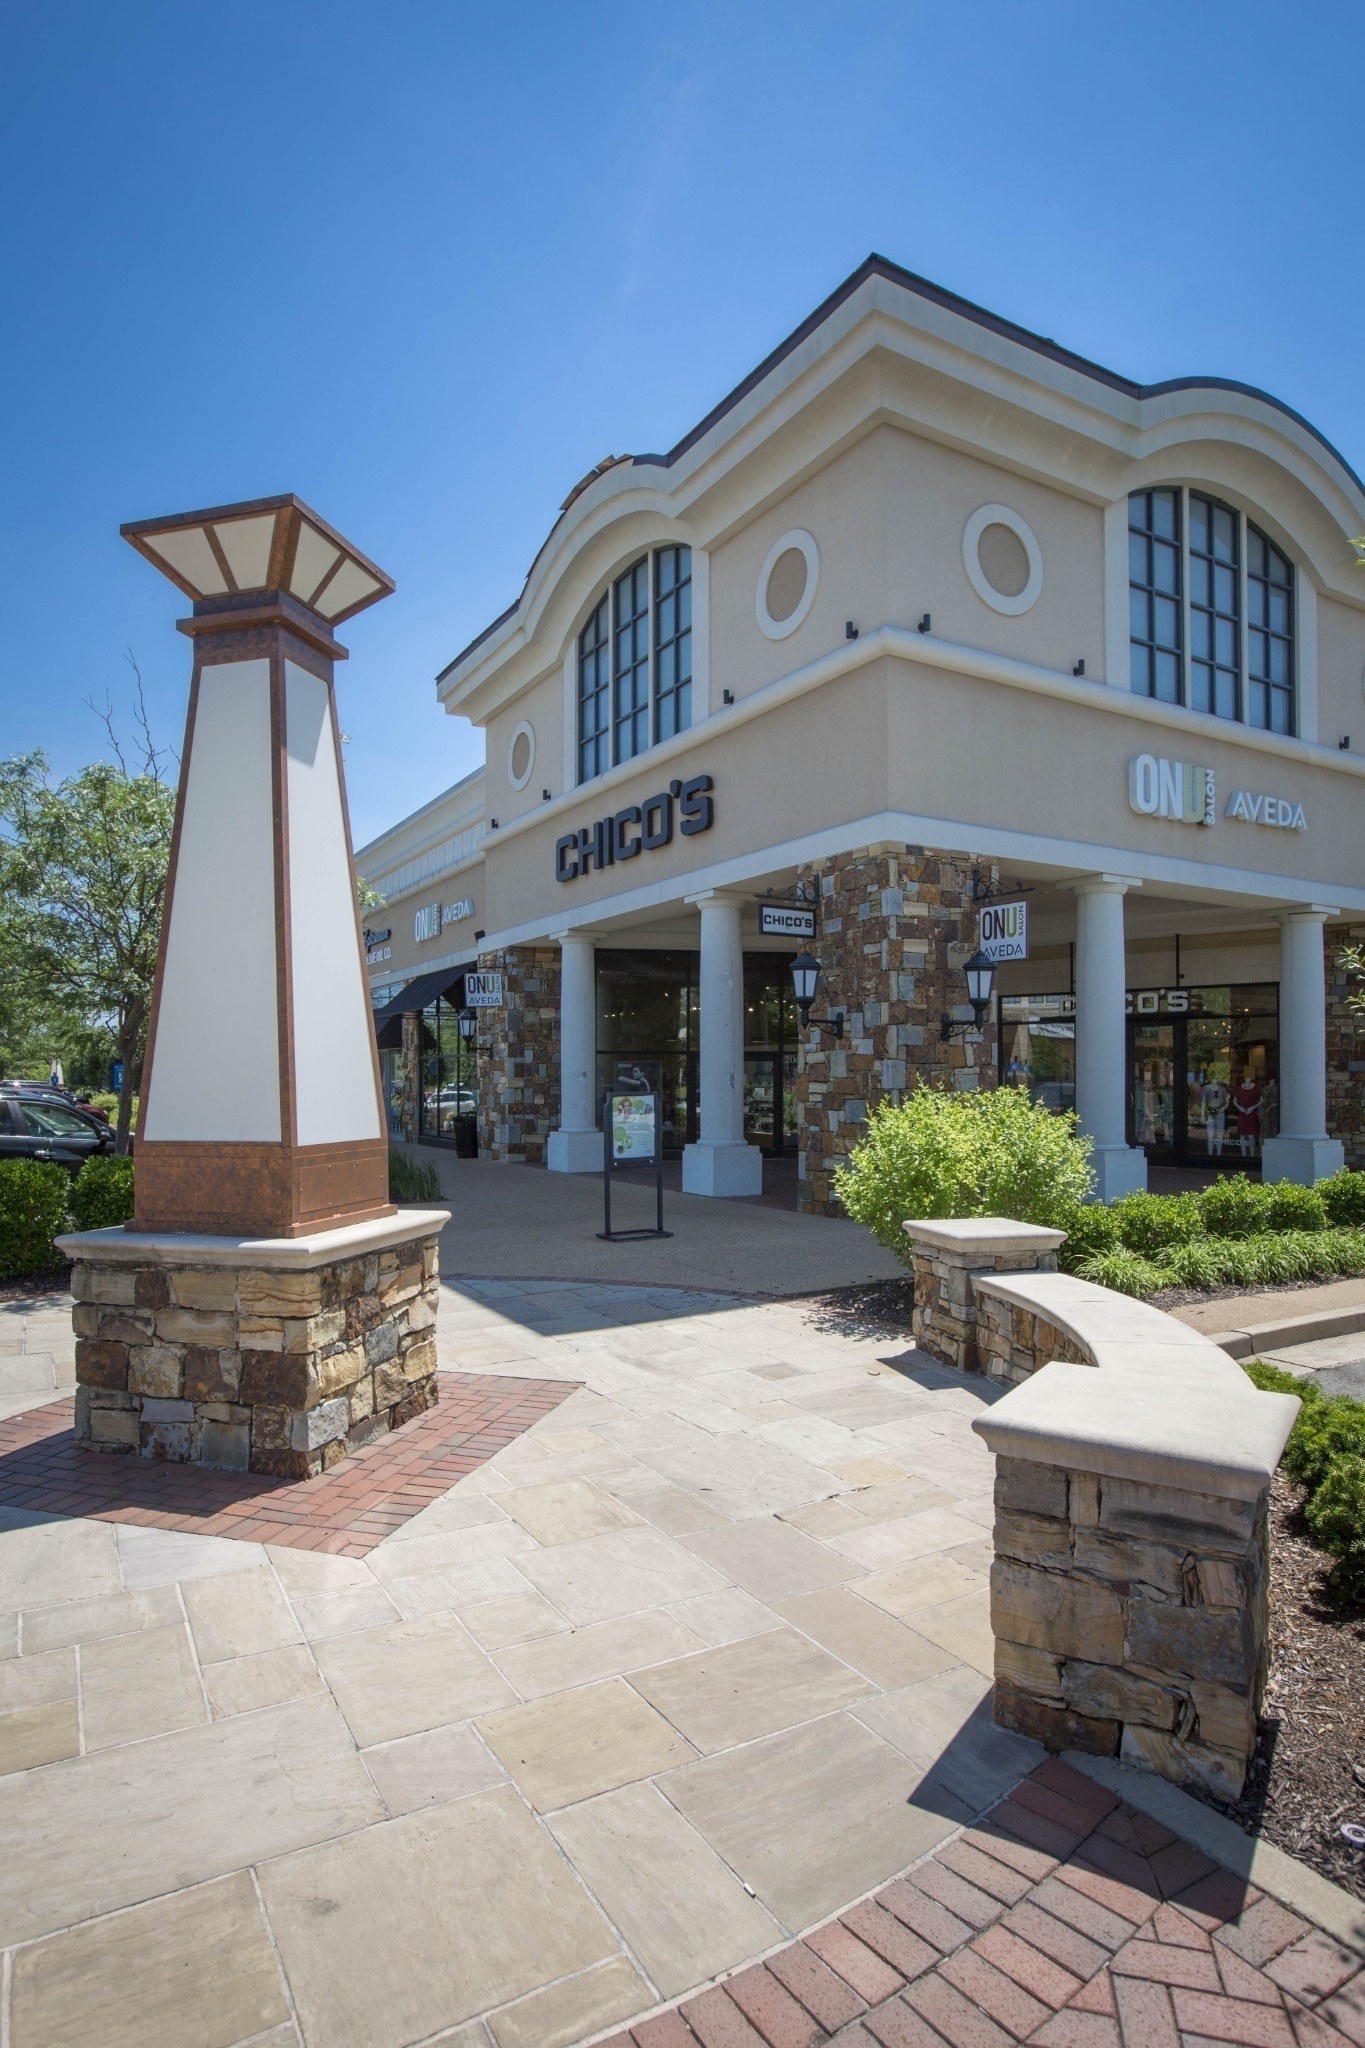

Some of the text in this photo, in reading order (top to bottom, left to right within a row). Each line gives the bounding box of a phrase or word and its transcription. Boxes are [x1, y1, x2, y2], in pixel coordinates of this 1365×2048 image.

[1130, 754, 1206, 823] ONU
[1206, 768, 1215, 827] SALON
[556, 774, 714, 882] CHICO'S
[1226, 790, 1308, 832] AVEDA
[415, 905, 434, 942] ONU
[441, 900, 471, 925] AVEDA
[763, 914, 813, 929] CHICO'S
[983, 907, 1017, 941] ONU
[984, 943, 1024, 958] AVEDA
[467, 975, 496, 994] ONU
[468, 996, 501, 1005] AVEDA
